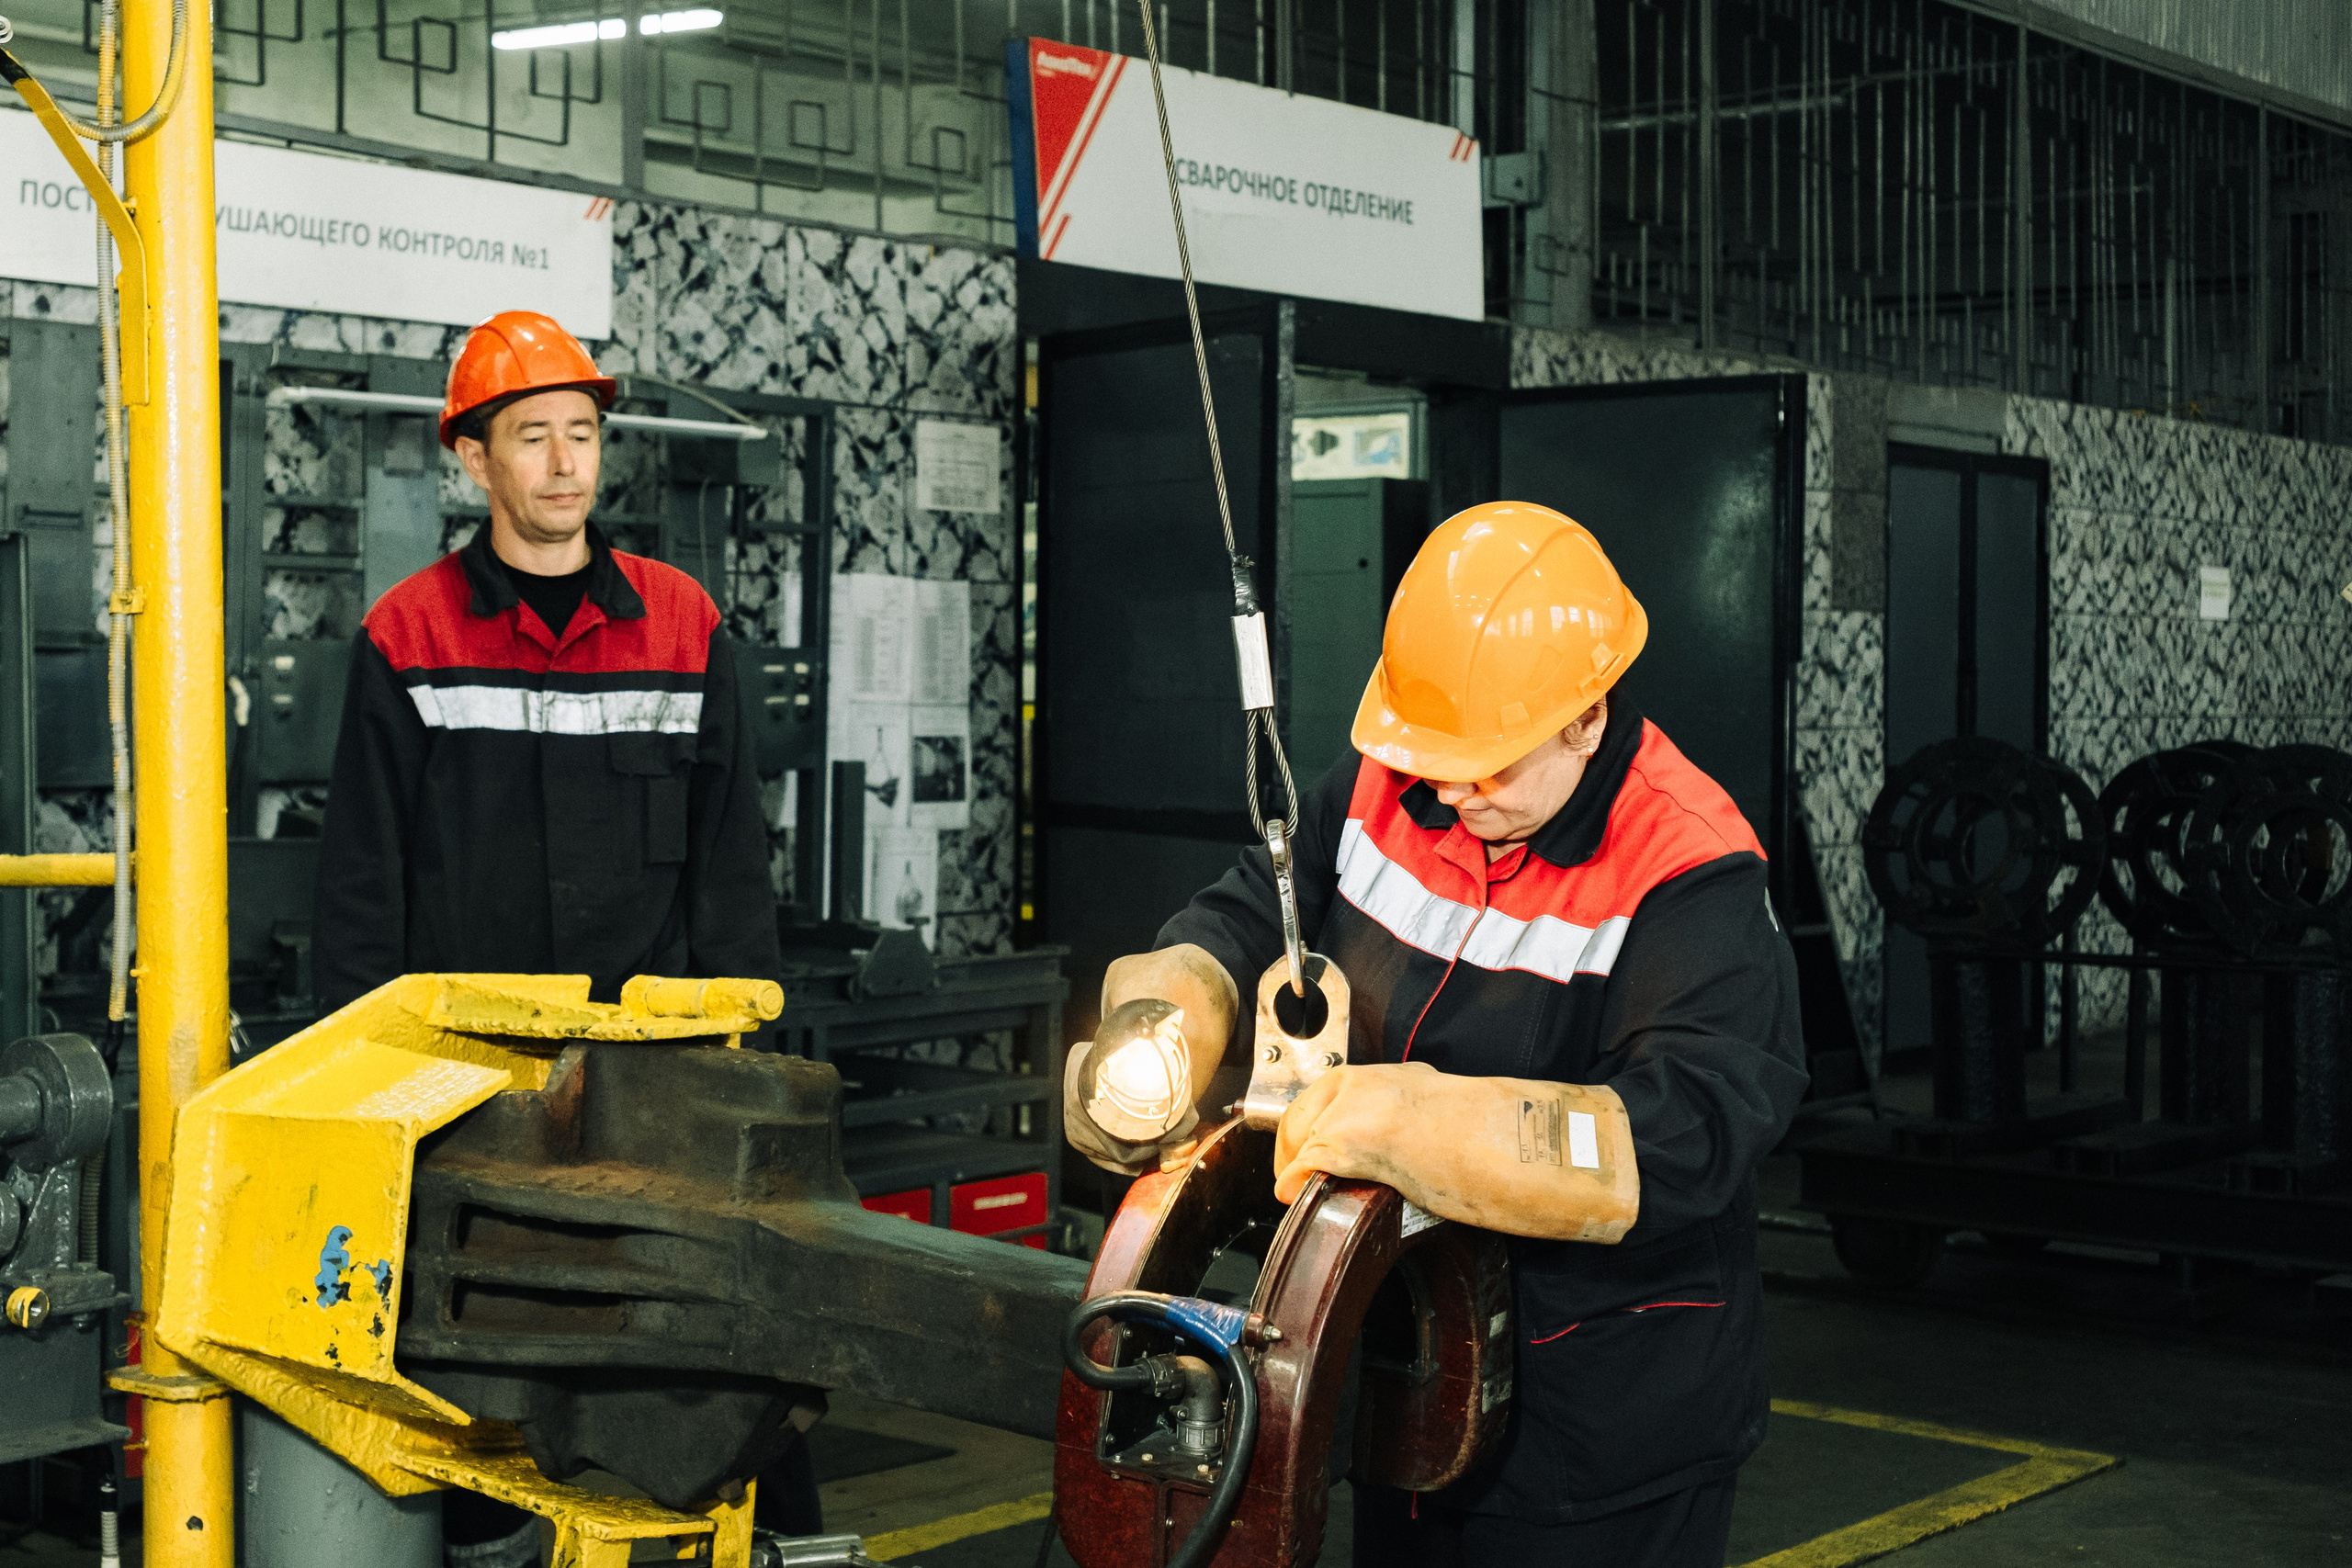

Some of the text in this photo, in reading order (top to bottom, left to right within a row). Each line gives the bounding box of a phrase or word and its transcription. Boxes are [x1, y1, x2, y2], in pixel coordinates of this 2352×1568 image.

[1175, 157, 1414, 226] СВАРОЧНОЕ ОТДЕЛЕНИЕ
[215, 205, 370, 247] УШАЮЩЕГО
[379, 226, 504, 264] КОНТРОЛЯ
[512, 243, 548, 270] №1
